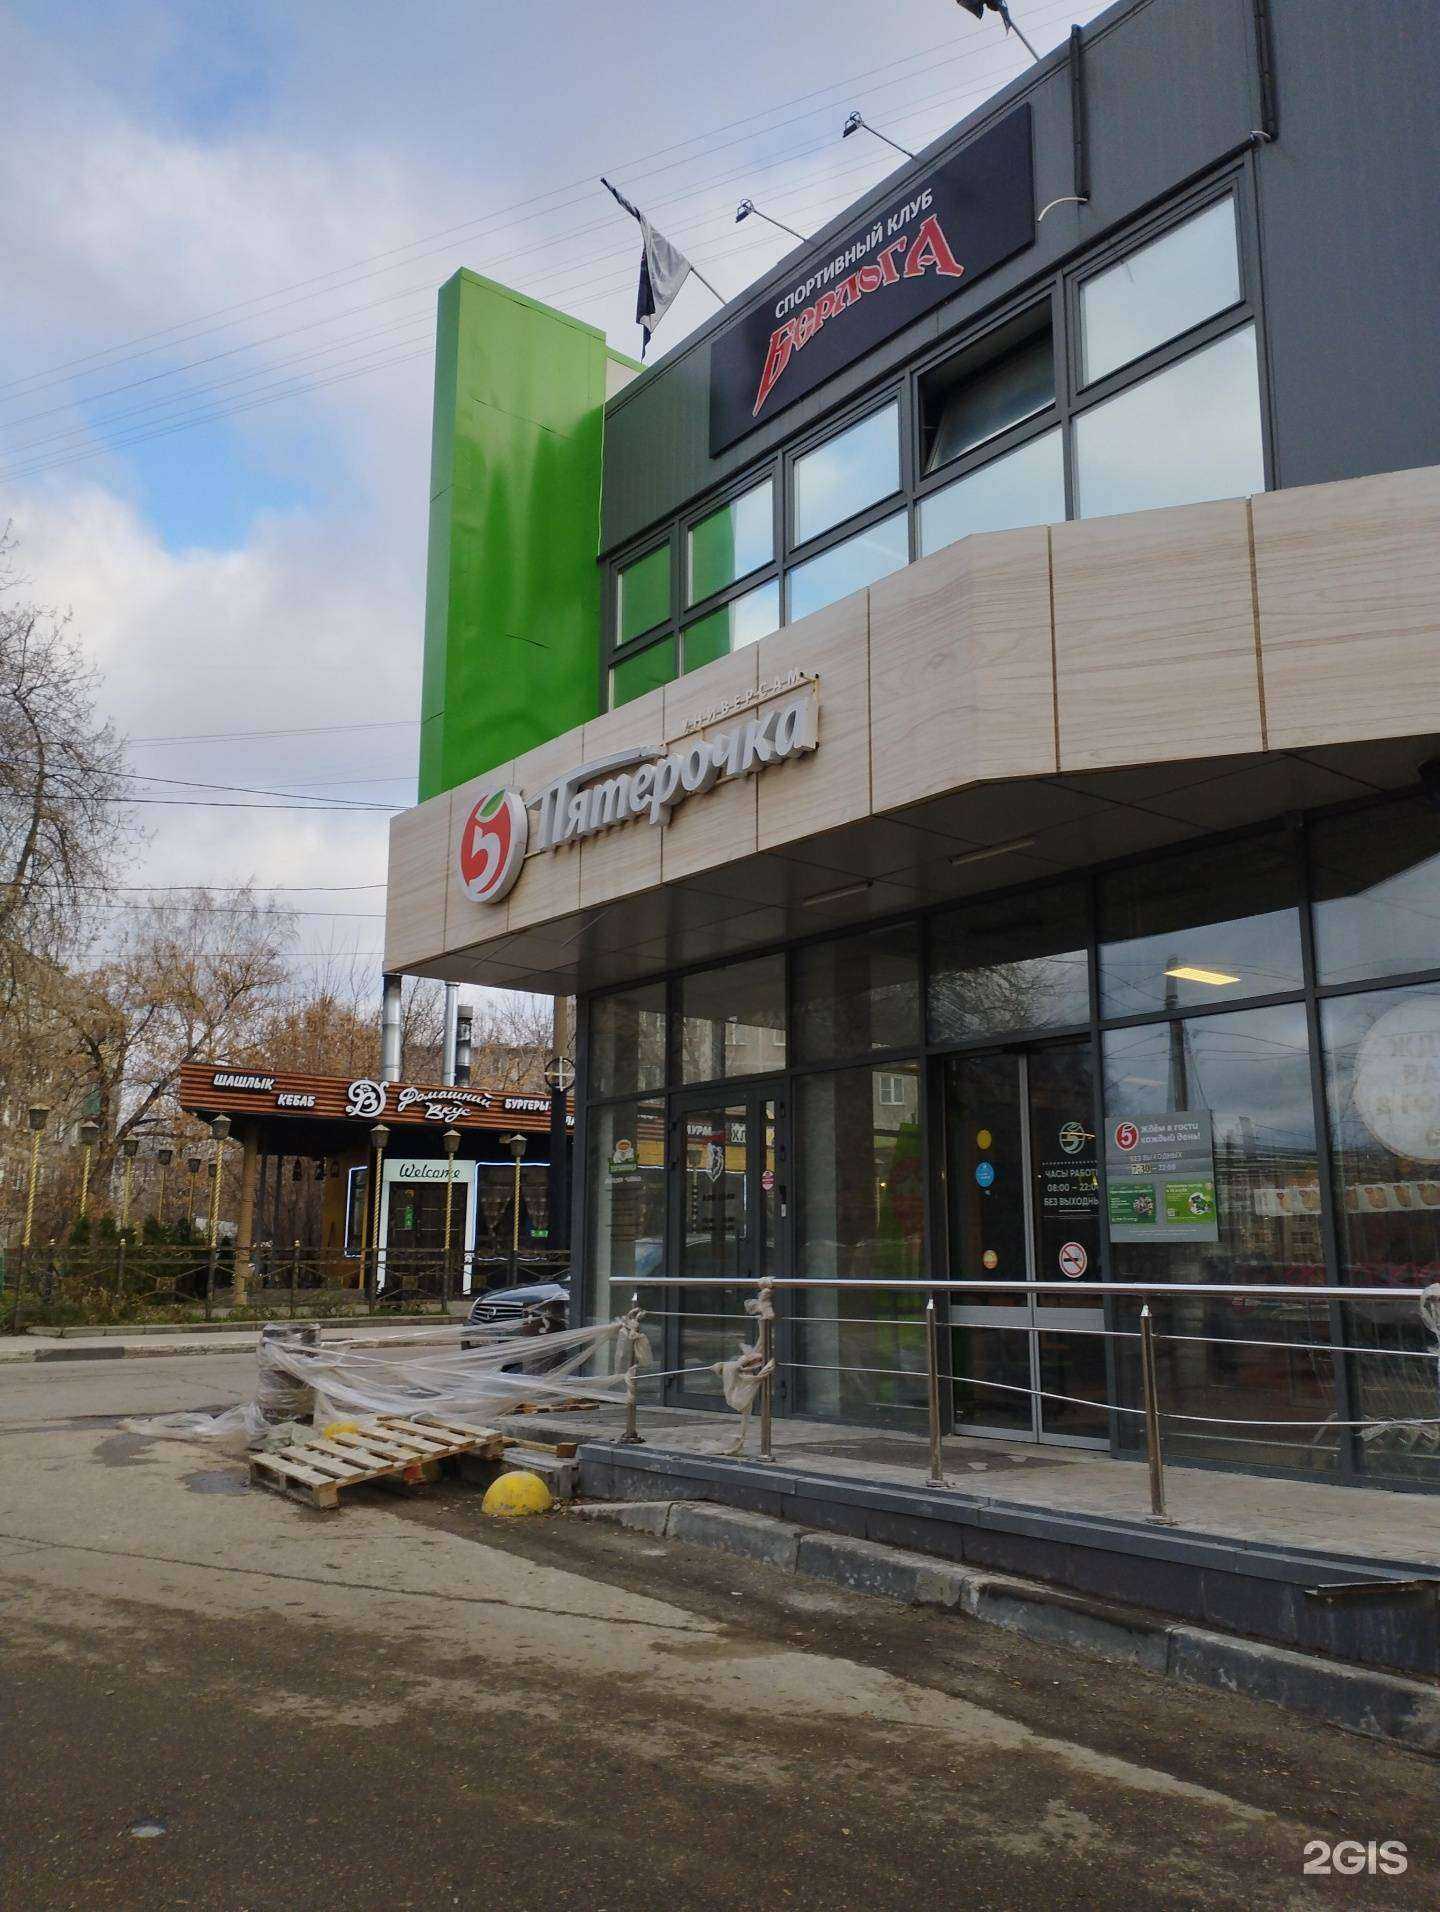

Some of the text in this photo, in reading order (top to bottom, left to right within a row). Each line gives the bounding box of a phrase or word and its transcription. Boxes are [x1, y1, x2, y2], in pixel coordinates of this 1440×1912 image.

[775, 188, 933, 318] СПОРТИВНЫЙ КЛУБ
[525, 698, 816, 850] Пятерочка
[213, 1074, 275, 1090] ШАШЛЫК
[277, 1094, 316, 1107] КЕБАБ
[398, 1087, 494, 1112] Домашний
[425, 1101, 472, 1122] Вкус
[1045, 1170, 1069, 1178] ЧАСЫ
[1044, 1198, 1058, 1206] БЕЗ
